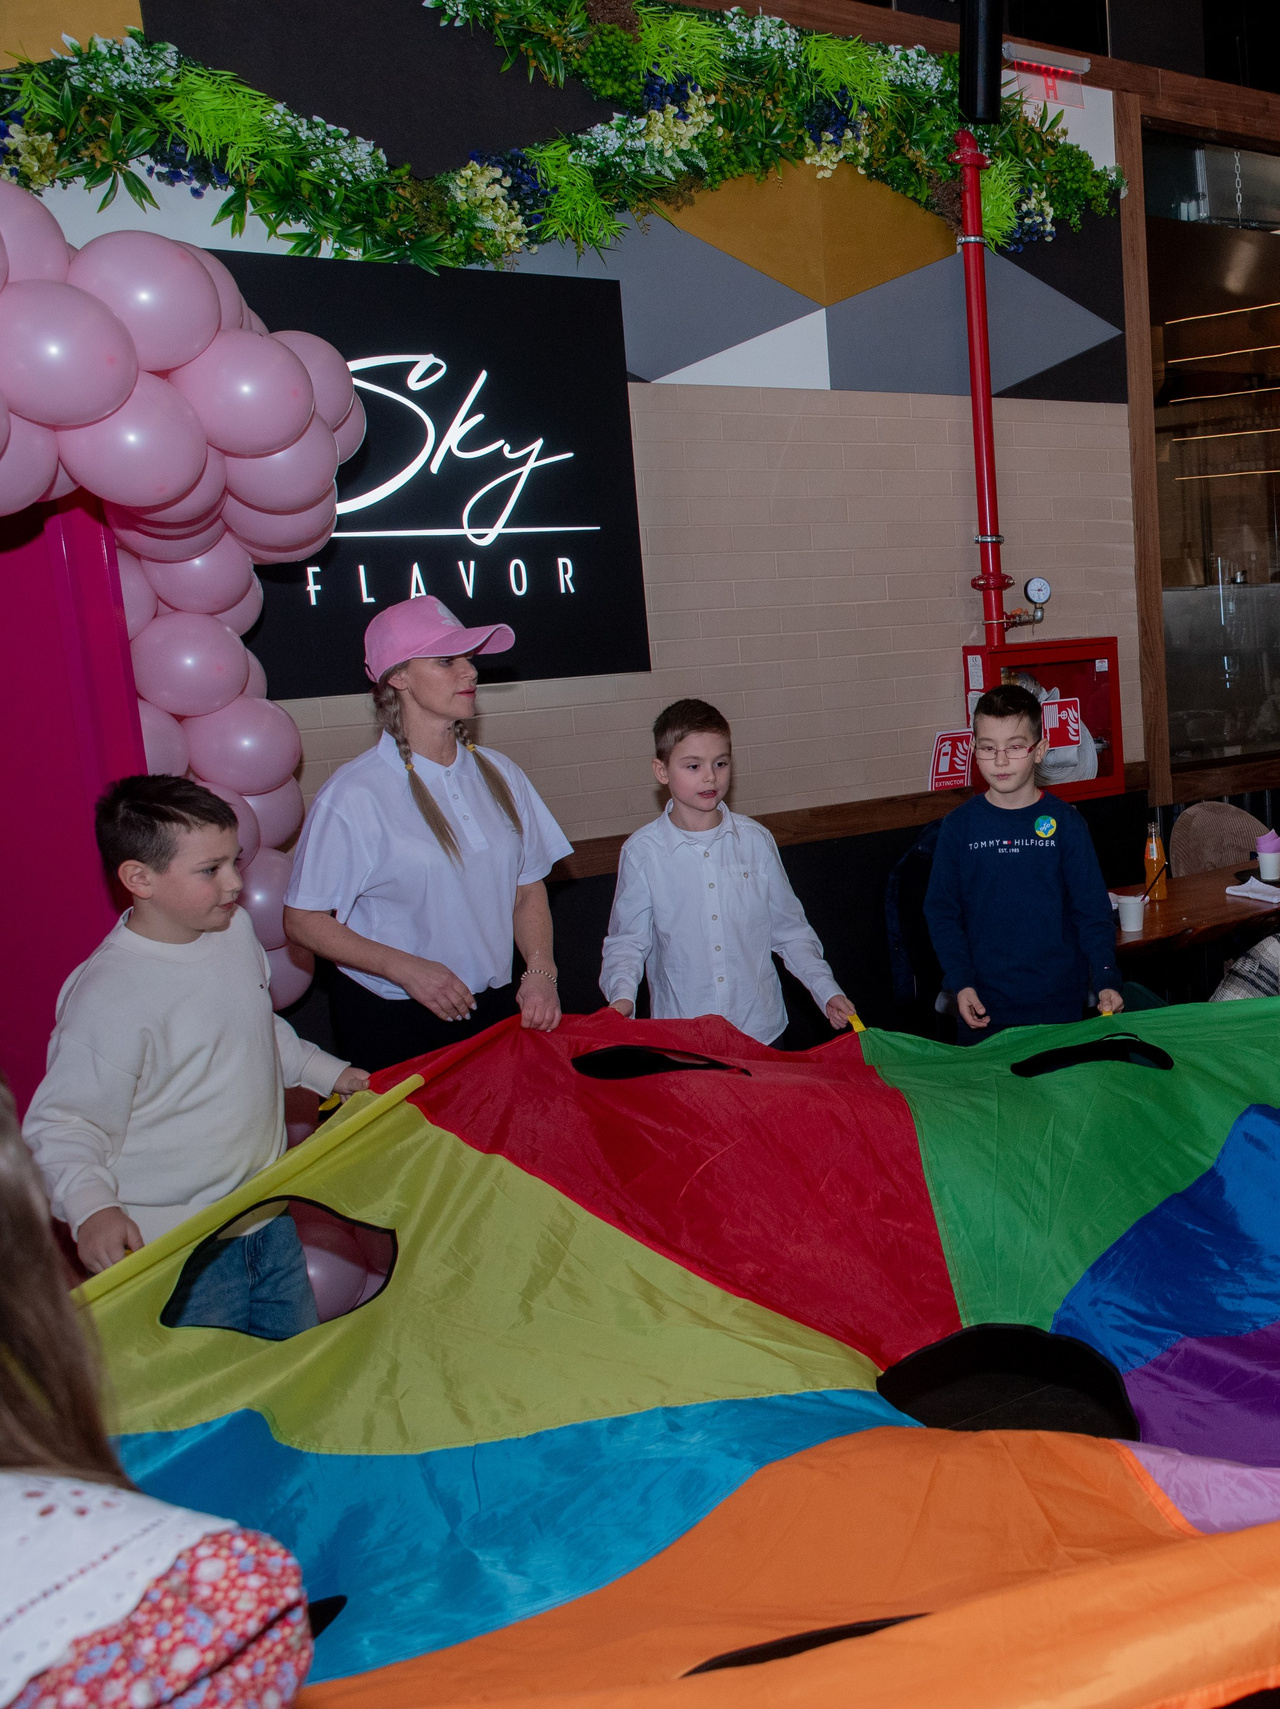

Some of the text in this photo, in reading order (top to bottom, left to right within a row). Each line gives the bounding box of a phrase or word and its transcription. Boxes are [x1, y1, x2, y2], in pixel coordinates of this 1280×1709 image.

[335, 353, 574, 546] Sky
[306, 557, 576, 606] FLAVOR
[935, 779, 964, 788] EXTINCTOR
[968, 839, 1056, 850] TOMMY HILFIGER
